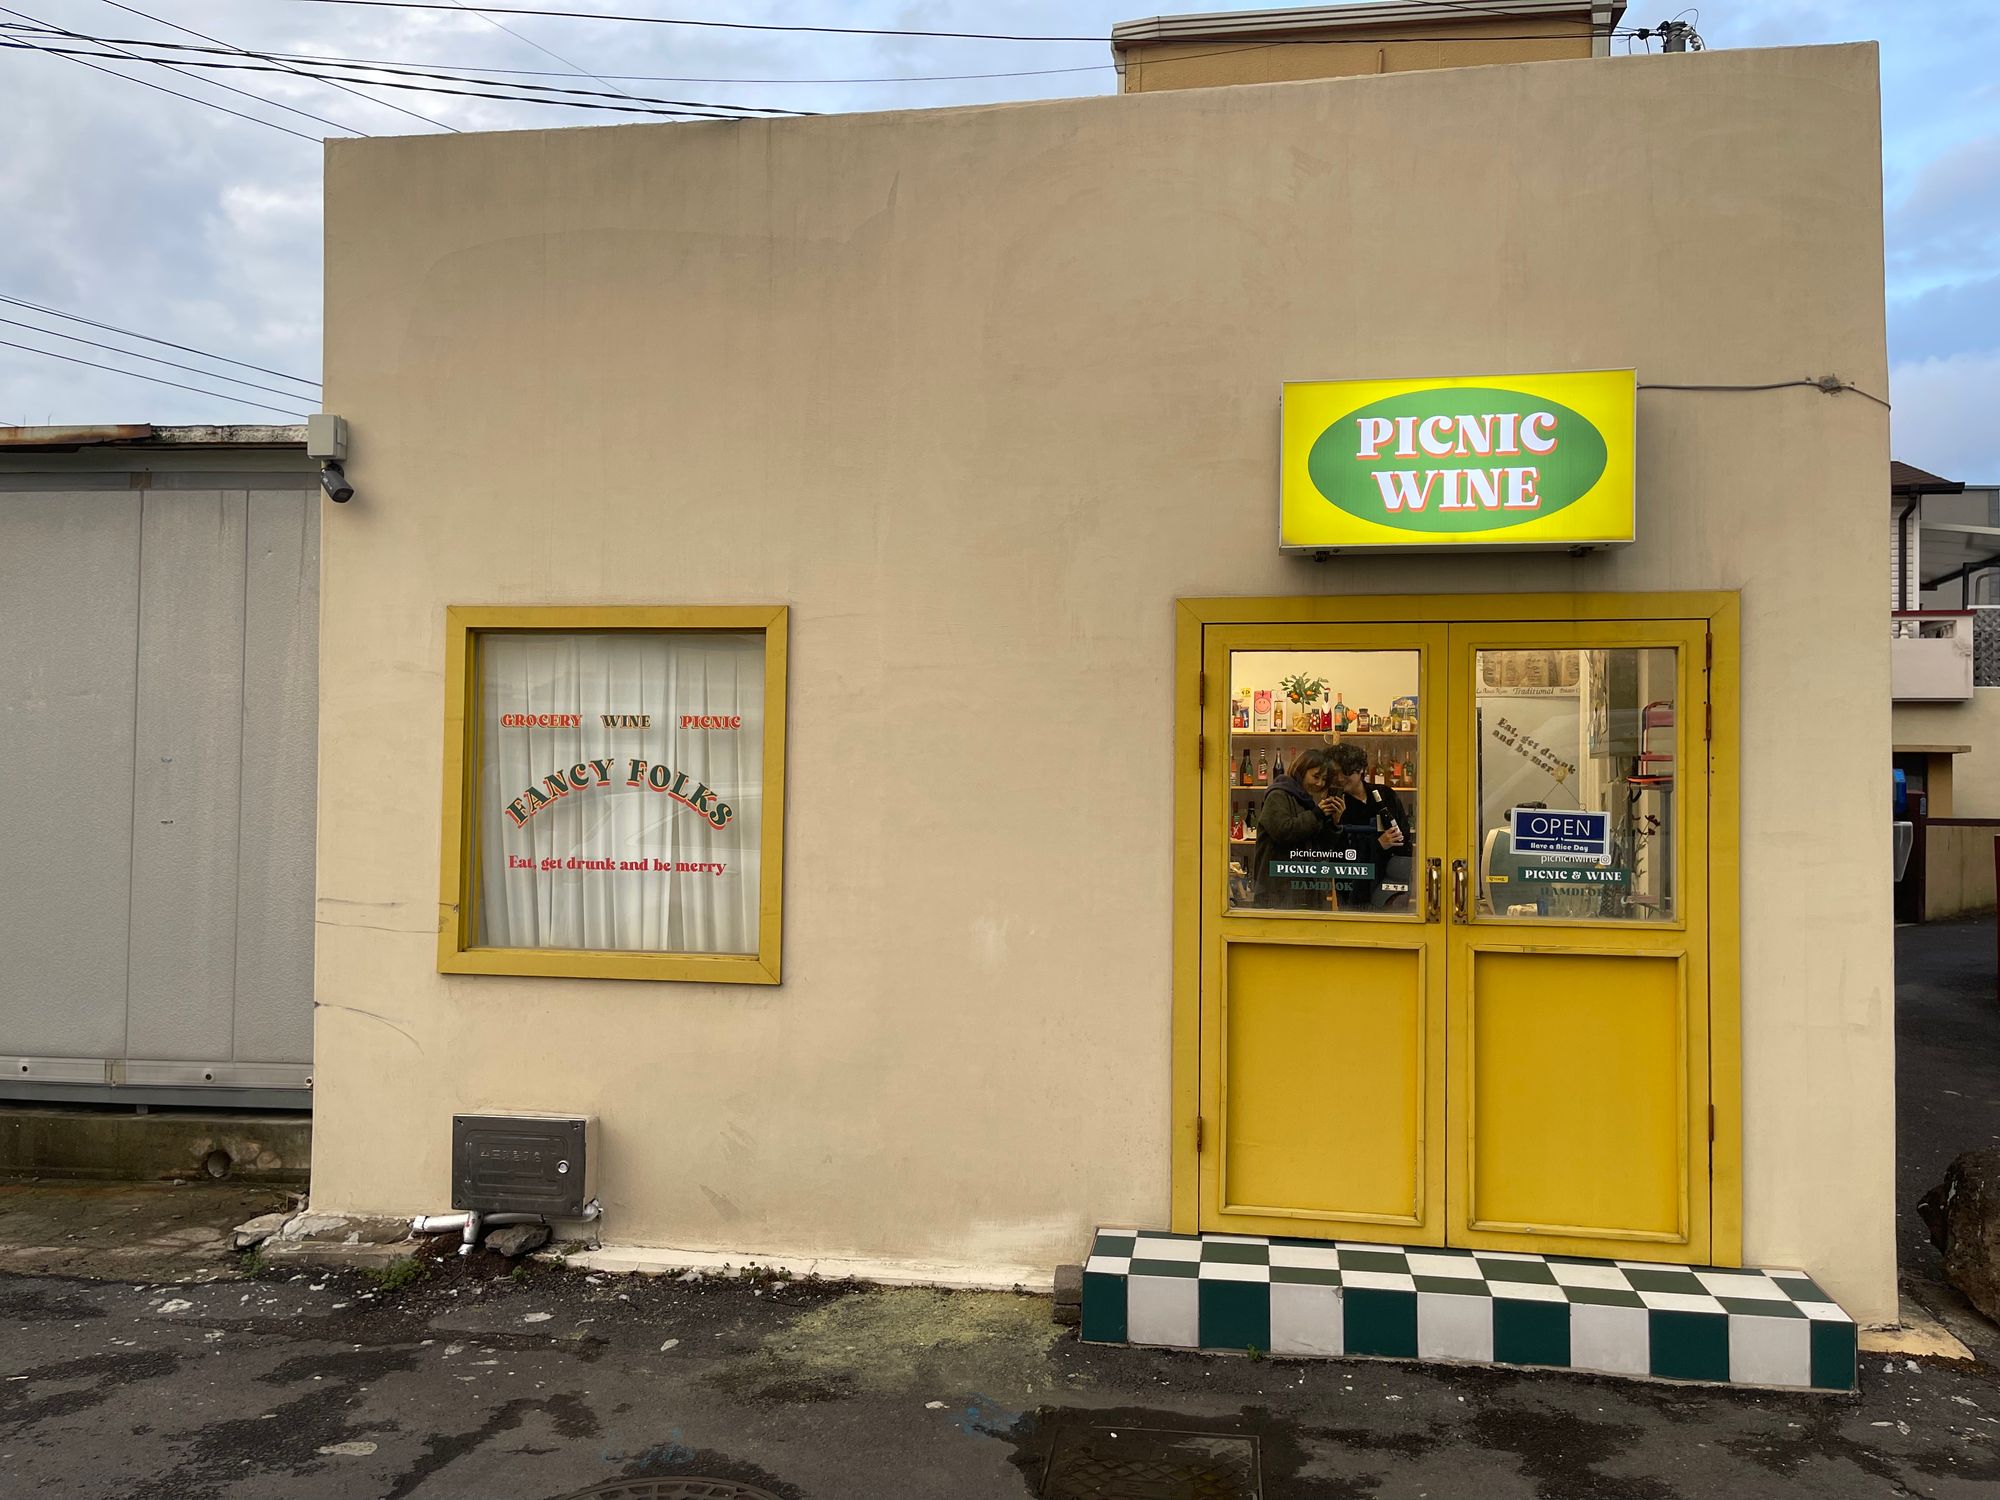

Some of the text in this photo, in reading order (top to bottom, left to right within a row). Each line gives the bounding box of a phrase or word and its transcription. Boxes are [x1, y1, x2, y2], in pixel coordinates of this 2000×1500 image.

[1355, 412, 1557, 460] PICNIC
[1371, 466, 1541, 513] WINE
[501, 714, 742, 729] GROCERY WINE PICNIC
[1491, 729, 1516, 747] and
[1514, 743, 1530, 757] be
[1497, 717, 1518, 738] Eat,
[1519, 735, 1540, 750] get
[505, 758, 734, 831] FANCY FOLKS
[1531, 817, 1590, 836] OPEN
[1290, 848, 1343, 859] picnicnwine
[1556, 843, 1572, 851] Nice
[1573, 844, 1589, 853] Day
[508, 855, 728, 876] Eat, get drunk and be merry
[1541, 854, 1598, 864] picnicnwine
[1276, 864, 1369, 876] PICNIC & WINE
[1525, 870, 1622, 881] PICNIC & WINE
